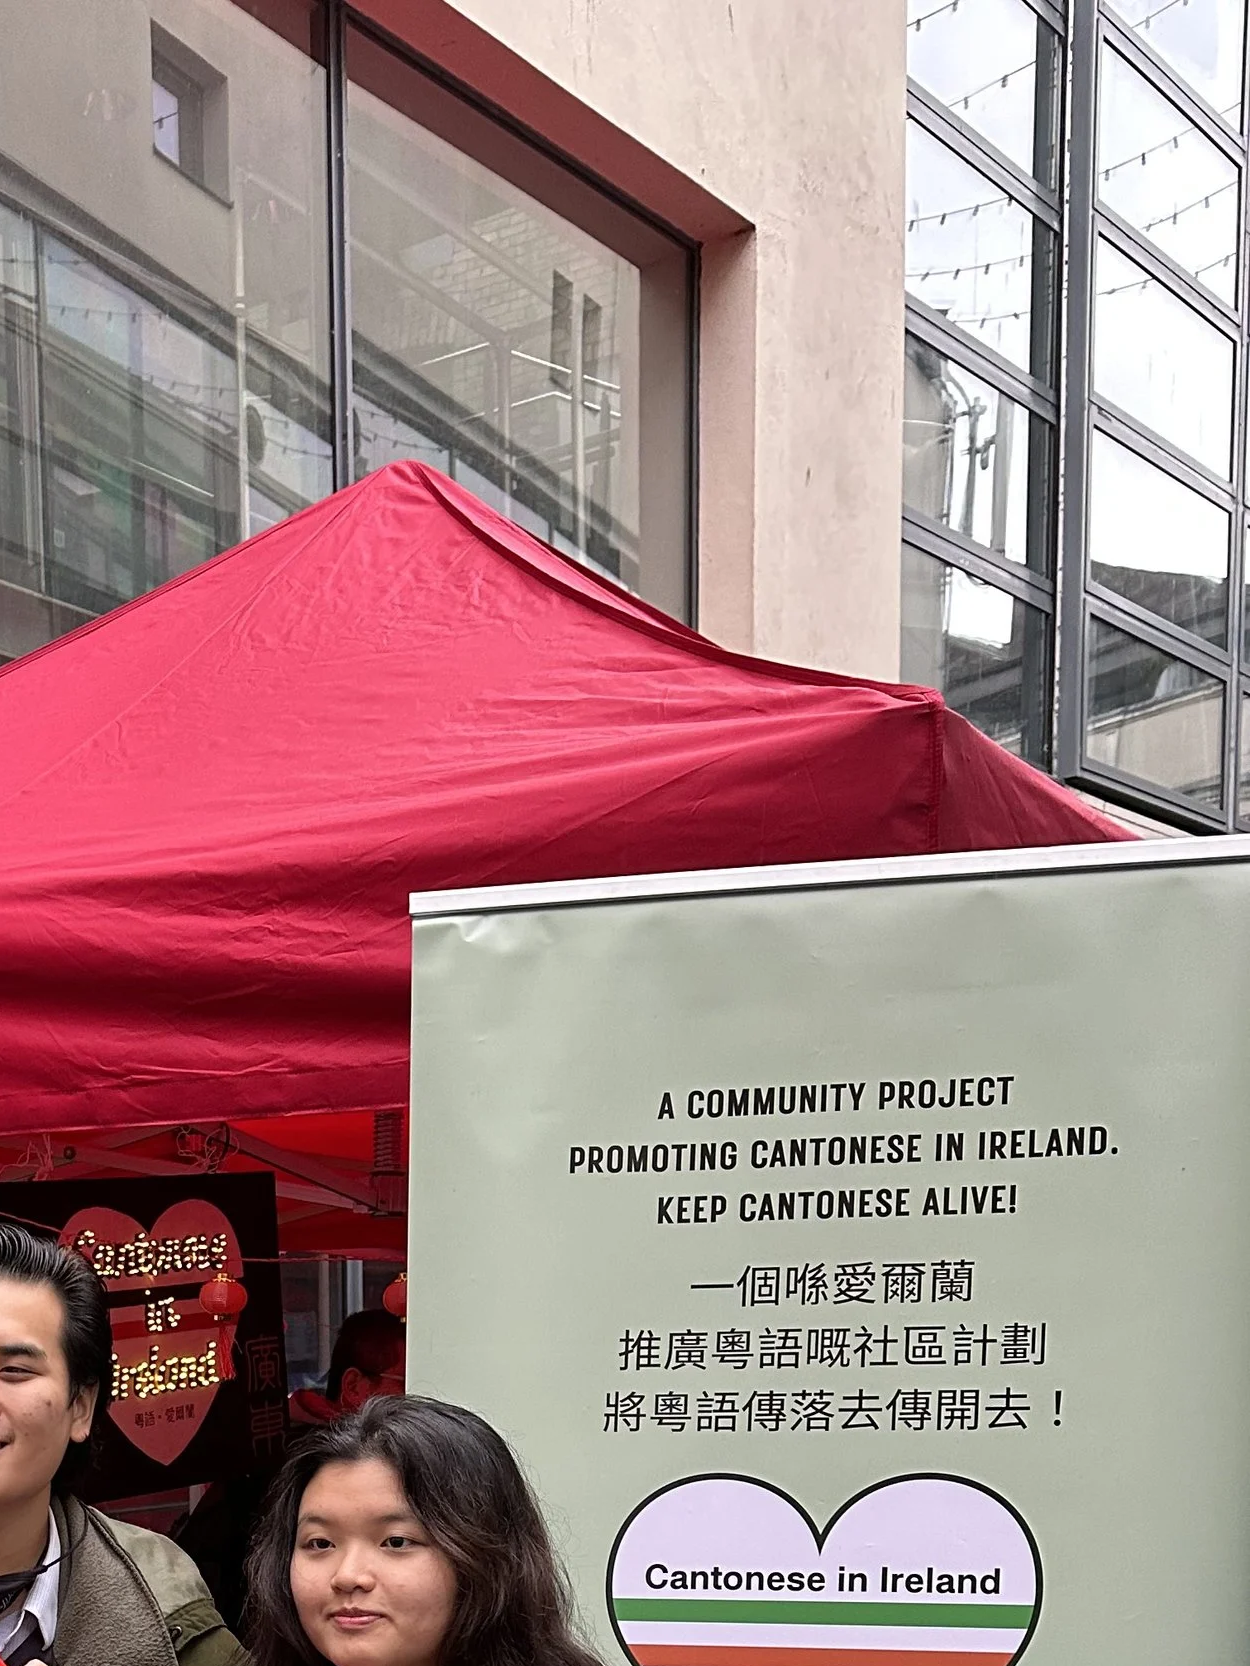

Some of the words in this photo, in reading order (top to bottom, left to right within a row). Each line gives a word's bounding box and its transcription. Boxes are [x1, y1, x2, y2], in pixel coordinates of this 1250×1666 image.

[657, 1093, 674, 1120] A
[686, 1083, 866, 1119] COMMUNITY
[878, 1076, 1015, 1110] PROJECT
[569, 1140, 738, 1175] PROMOTING
[750, 1133, 922, 1168] CANTONESE
[935, 1131, 964, 1162] IN
[978, 1126, 1119, 1160] IRELAND.
[657, 1194, 728, 1225] KEEP
[739, 1189, 911, 1221] CANTONESE
[922, 1185, 1018, 1217] ALIVE!
[690, 1260, 975, 1307] 一個喺愛爾蘭
[618, 1323, 1048, 1372] 推廣粵語嘅社區計劃
[644, 1563, 826, 1592] Cantonese
[837, 1566, 868, 1593] in
[880, 1566, 1001, 1595] Ireland
